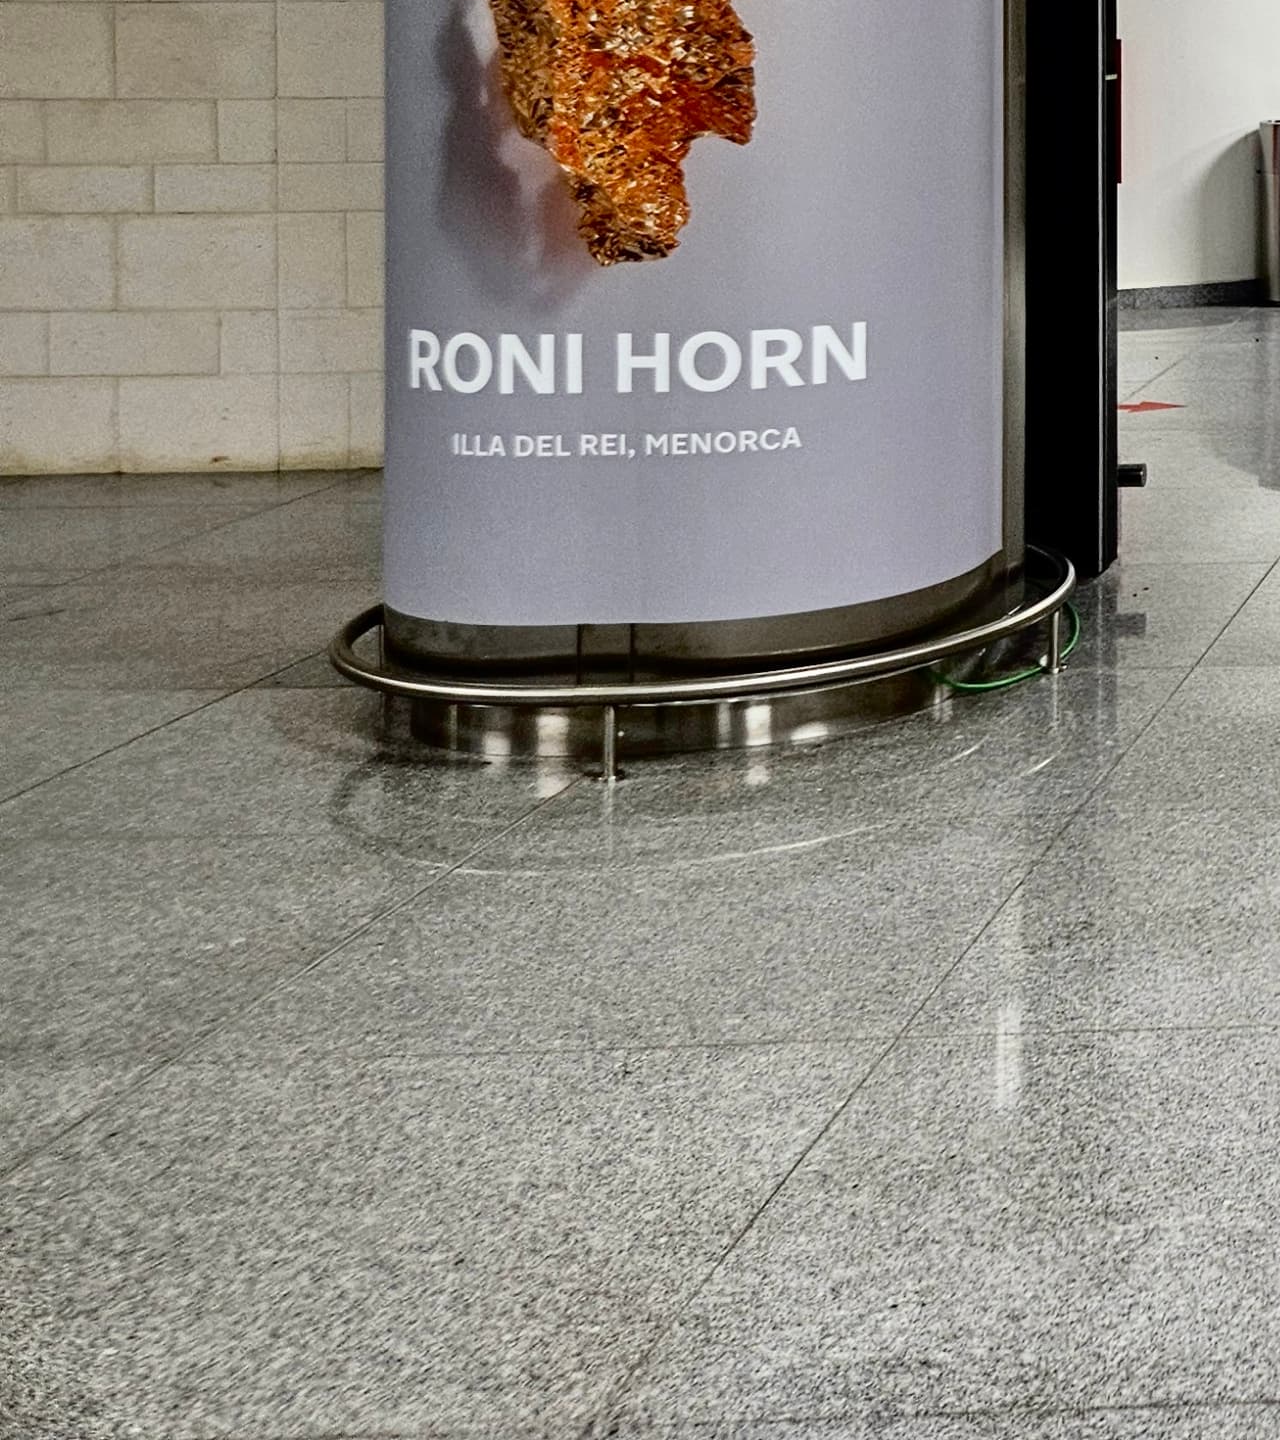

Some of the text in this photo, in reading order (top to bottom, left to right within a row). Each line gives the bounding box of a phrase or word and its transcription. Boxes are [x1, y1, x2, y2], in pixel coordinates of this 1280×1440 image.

[407, 320, 869, 395] RONI HORN
[452, 426, 804, 460] ILLA DEL REI, MENORCA
